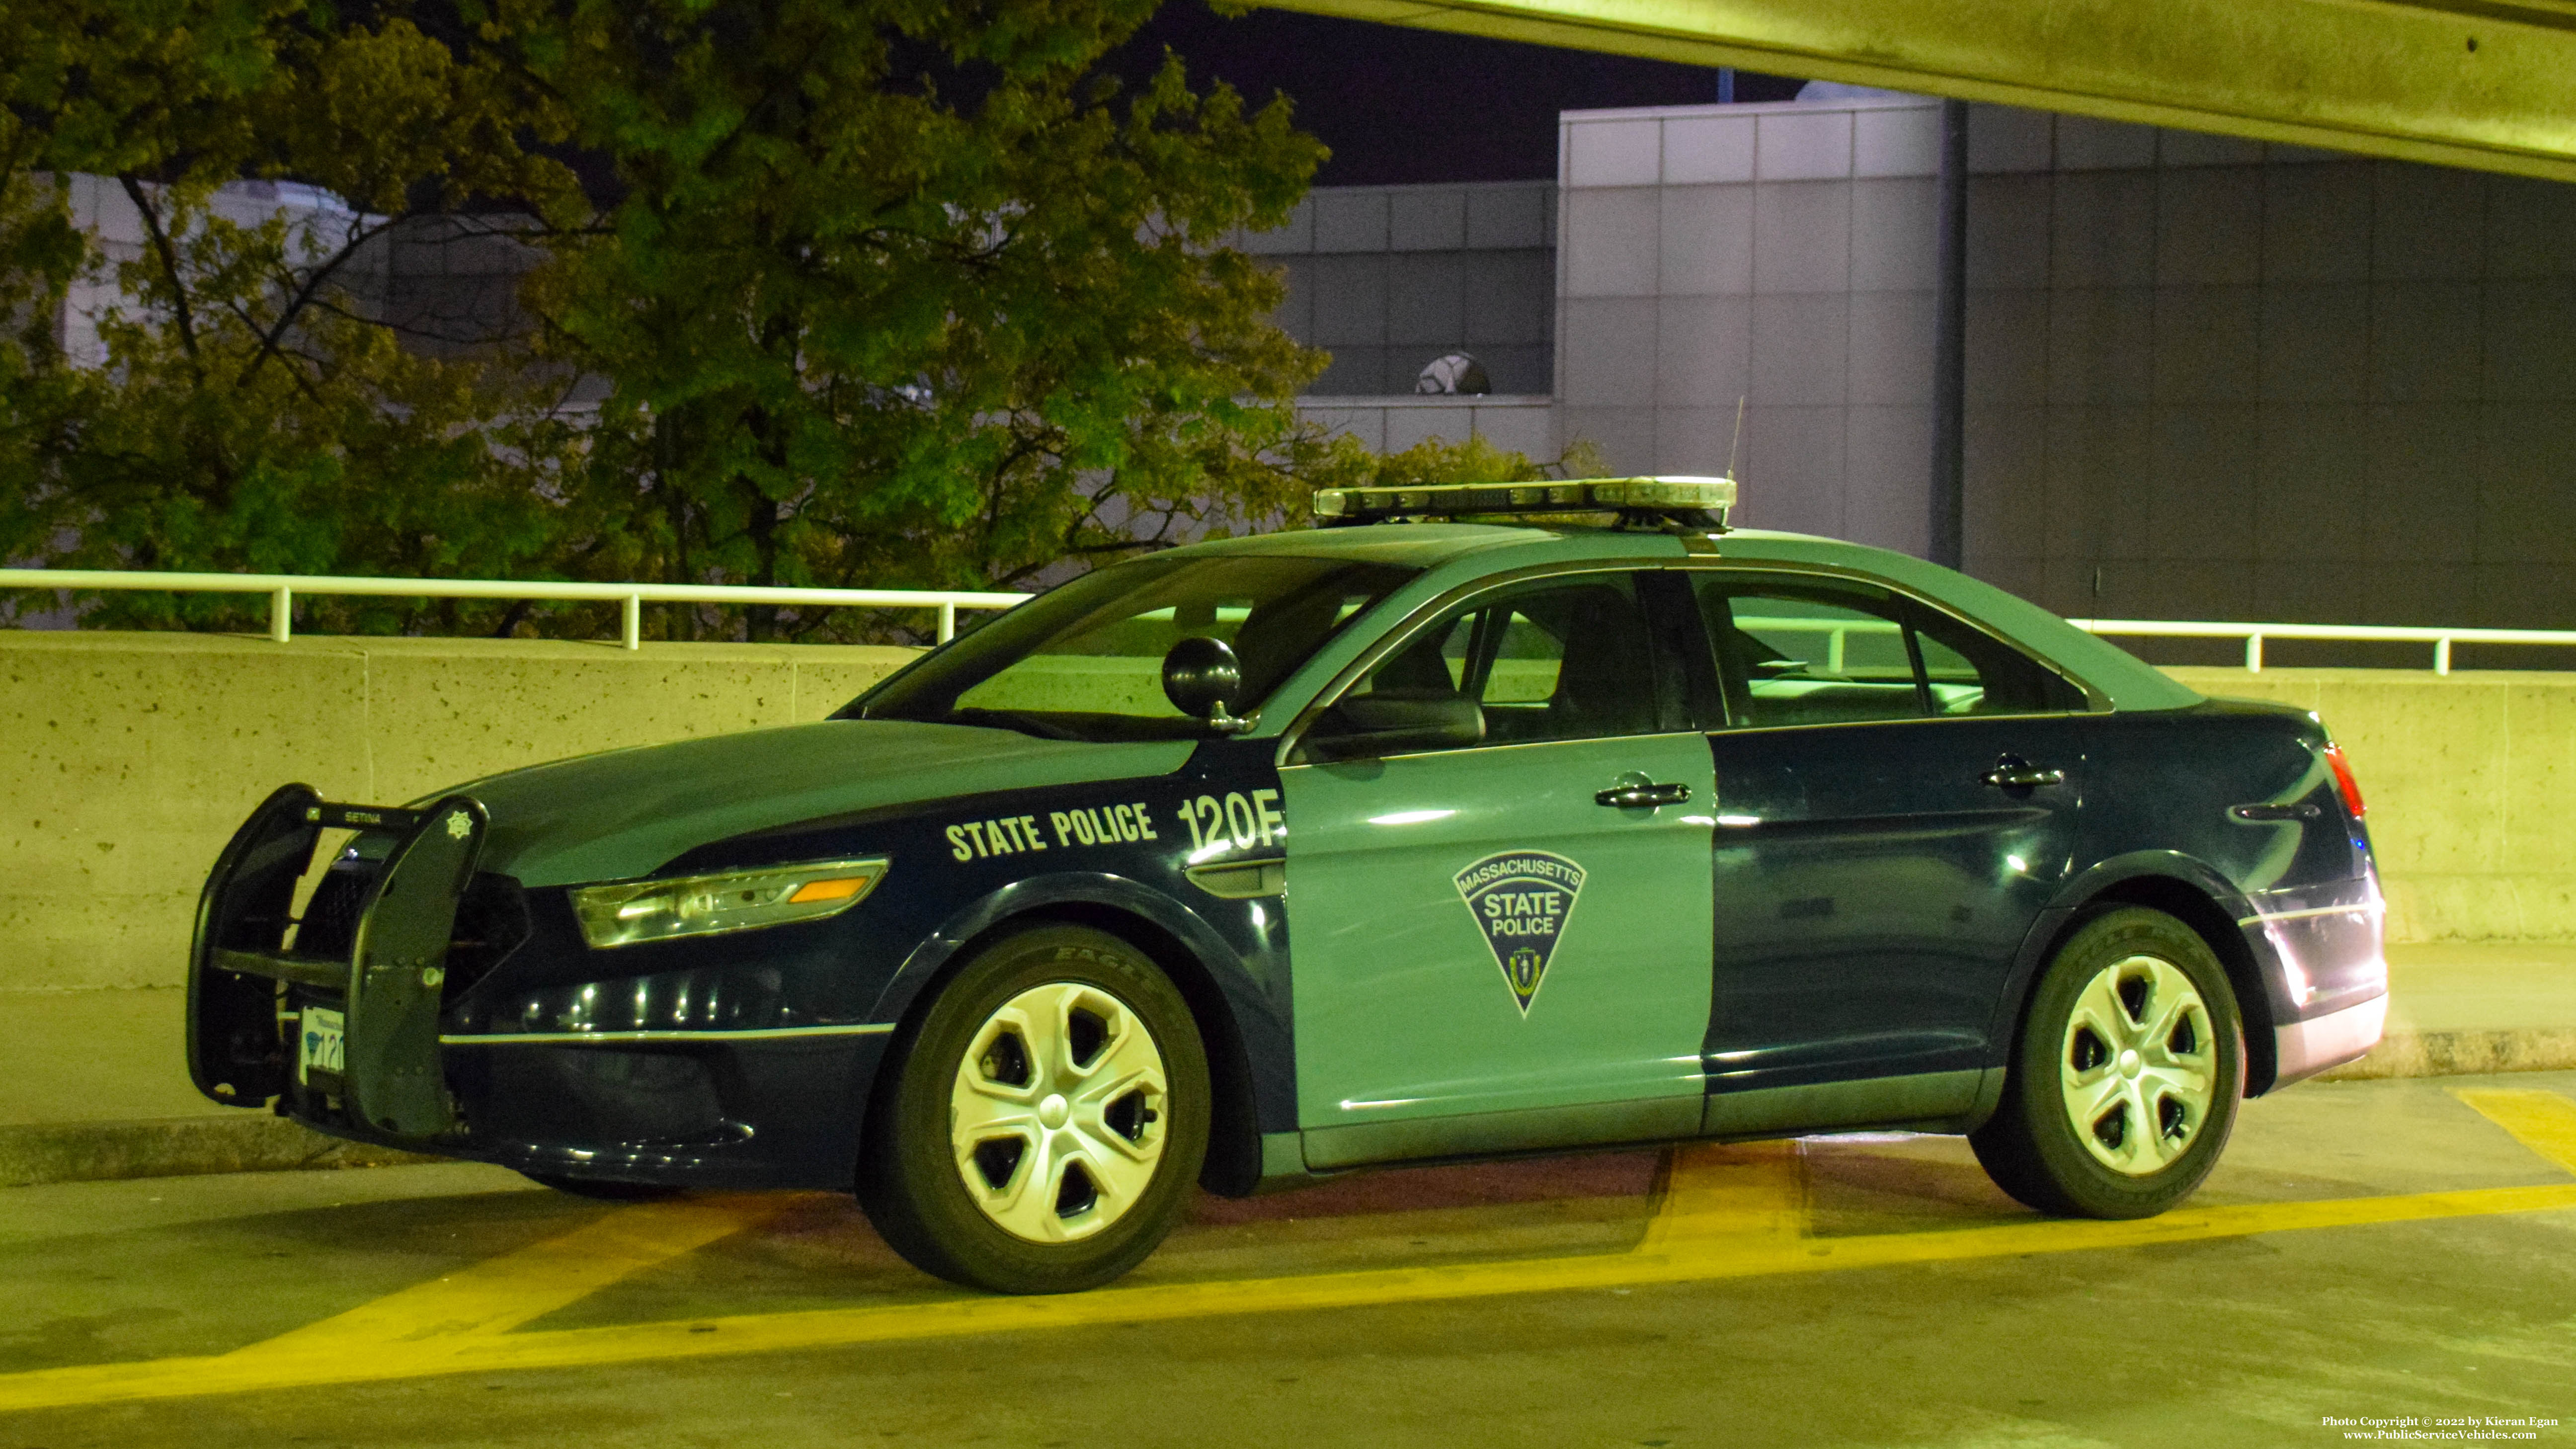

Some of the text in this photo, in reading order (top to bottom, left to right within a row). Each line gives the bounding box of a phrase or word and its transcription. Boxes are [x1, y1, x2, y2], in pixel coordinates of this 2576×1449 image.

[345, 811, 381, 824] SETINA
[1177, 788, 1282, 854] 120F
[947, 803, 1158, 863] STATE POLICE
[1459, 859, 1582, 892] MASSACHUSETTS
[1484, 892, 1561, 917] STATE
[1492, 917, 1554, 936] POLICE
